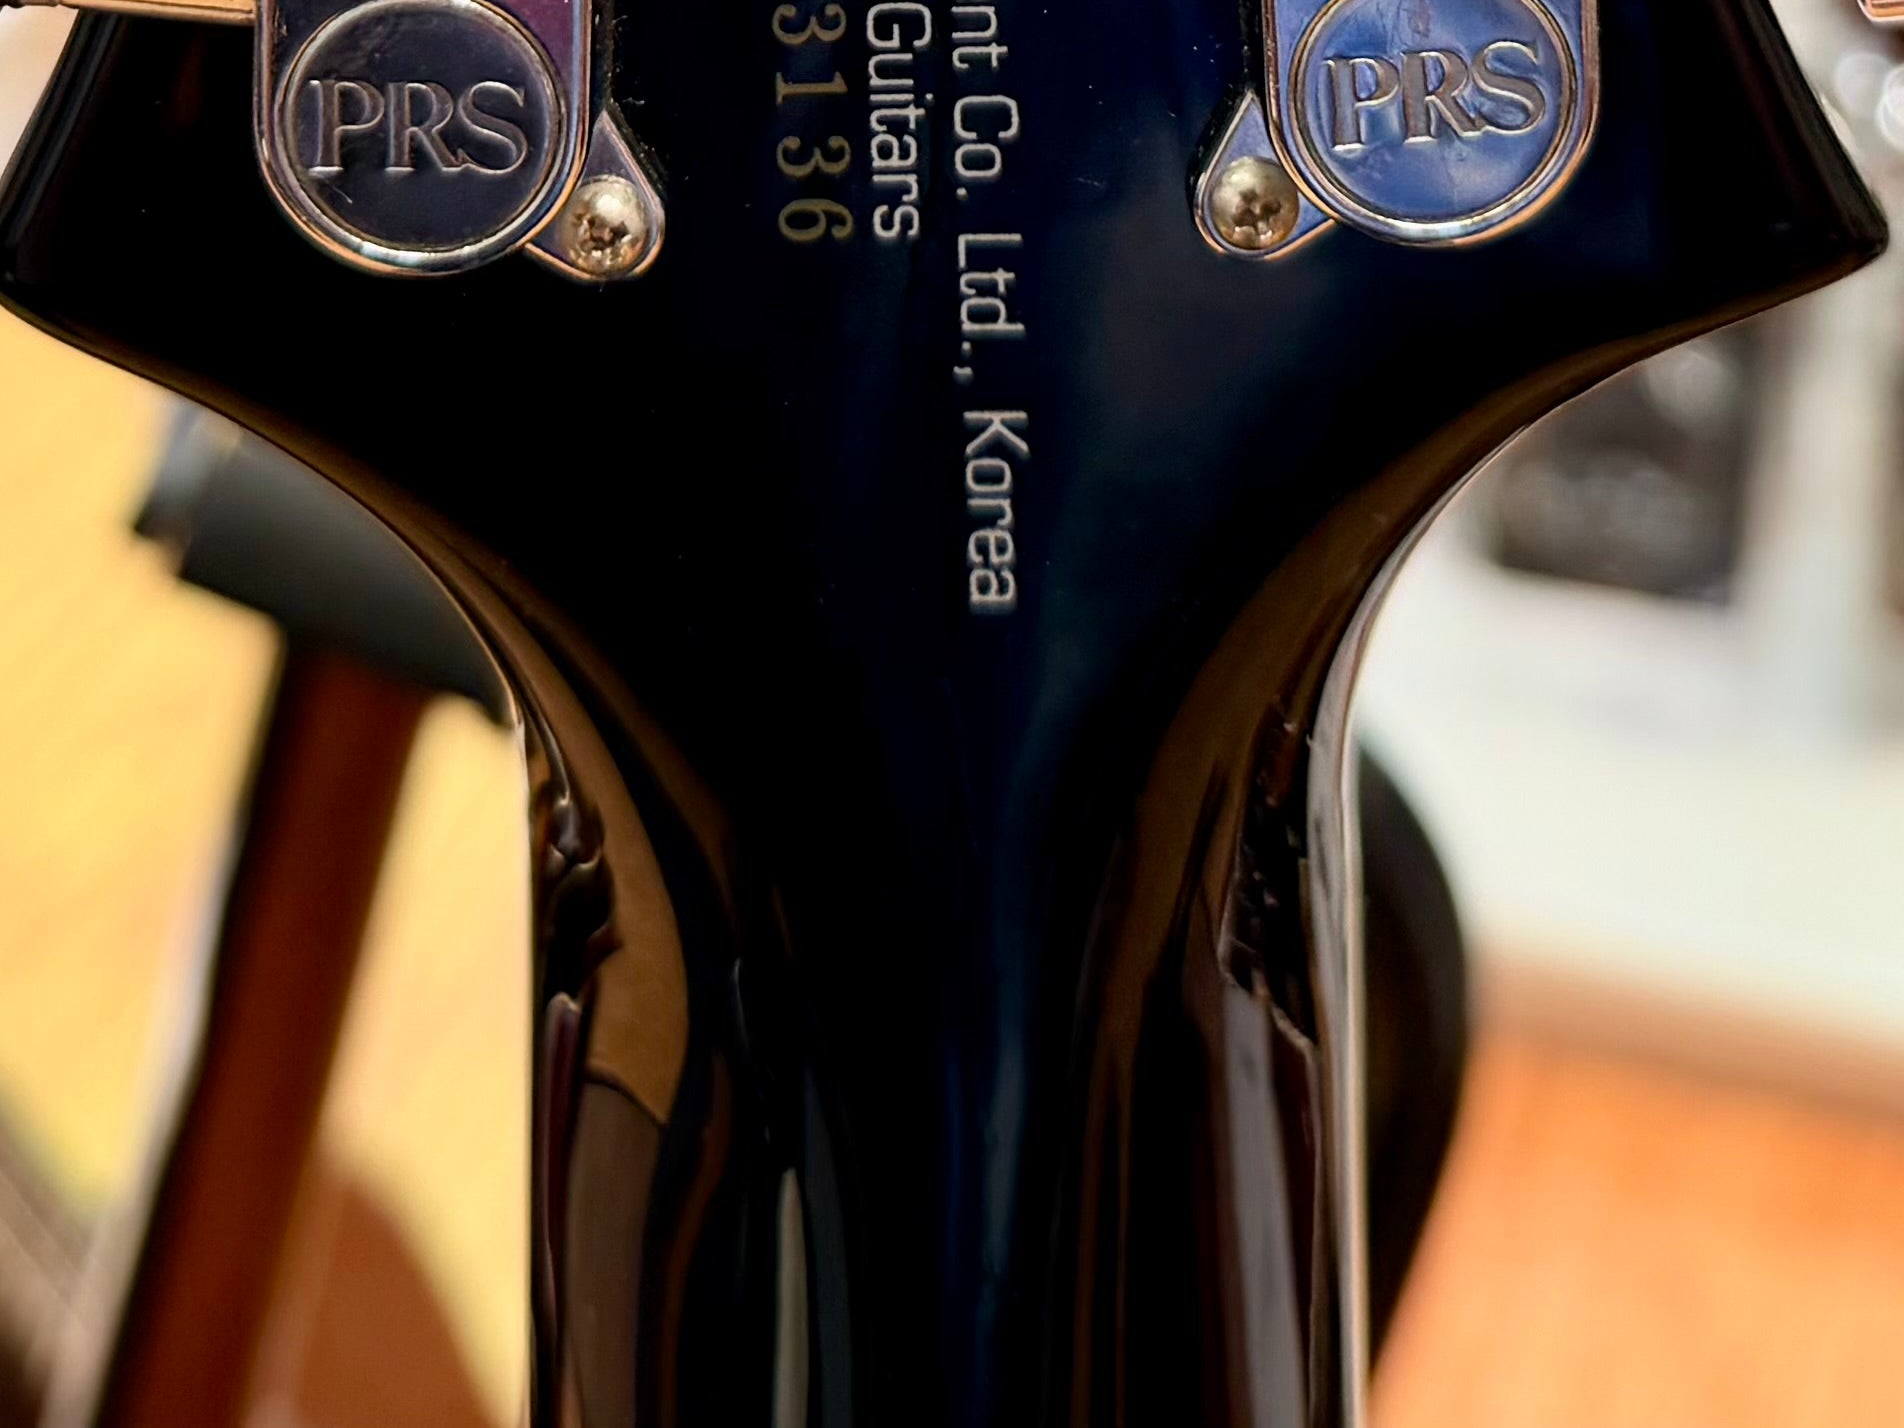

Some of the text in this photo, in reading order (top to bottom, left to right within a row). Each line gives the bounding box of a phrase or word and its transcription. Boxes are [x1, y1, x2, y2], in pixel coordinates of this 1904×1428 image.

[304, 76, 533, 176] PRS
[865, 1, 935, 242] Guitars
[953, 94, 1021, 197] Co.
[1325, 40, 1545, 151] PRS
[953, 232, 1026, 380] Ltd.,
[962, 410, 1030, 610] Korea
